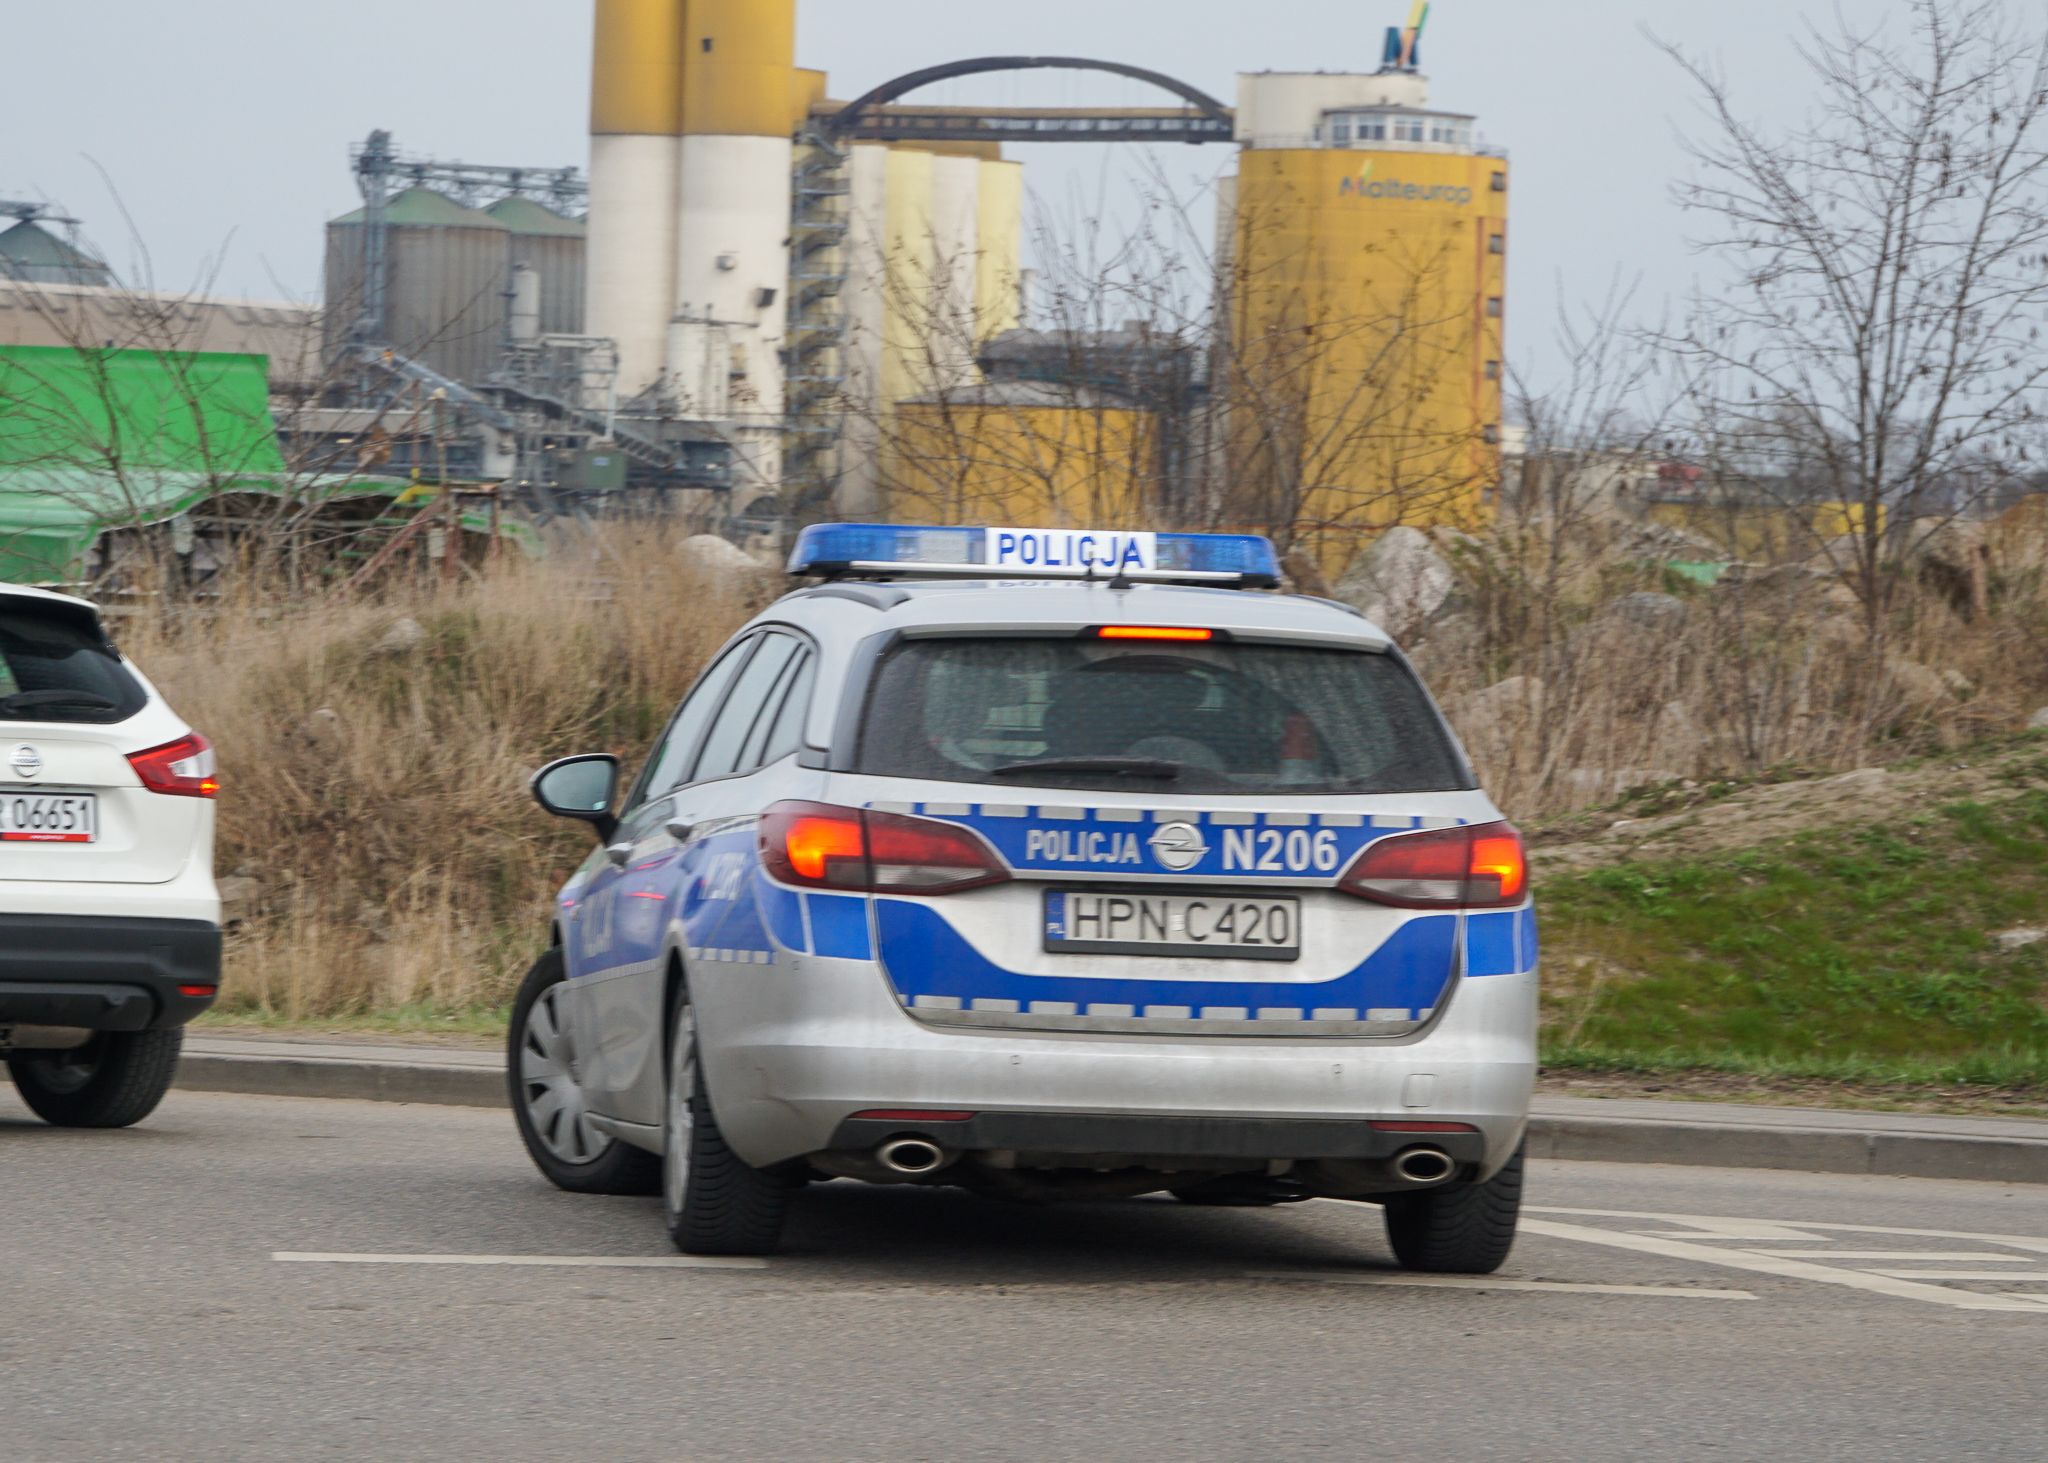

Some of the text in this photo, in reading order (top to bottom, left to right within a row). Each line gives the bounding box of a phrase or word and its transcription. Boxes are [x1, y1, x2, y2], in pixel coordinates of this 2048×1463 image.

[998, 533, 1145, 568] POLICJA
[12, 798, 90, 830] 06651
[1025, 828, 1340, 872] POLICJA N206
[1073, 897, 1290, 946] HPN C420
